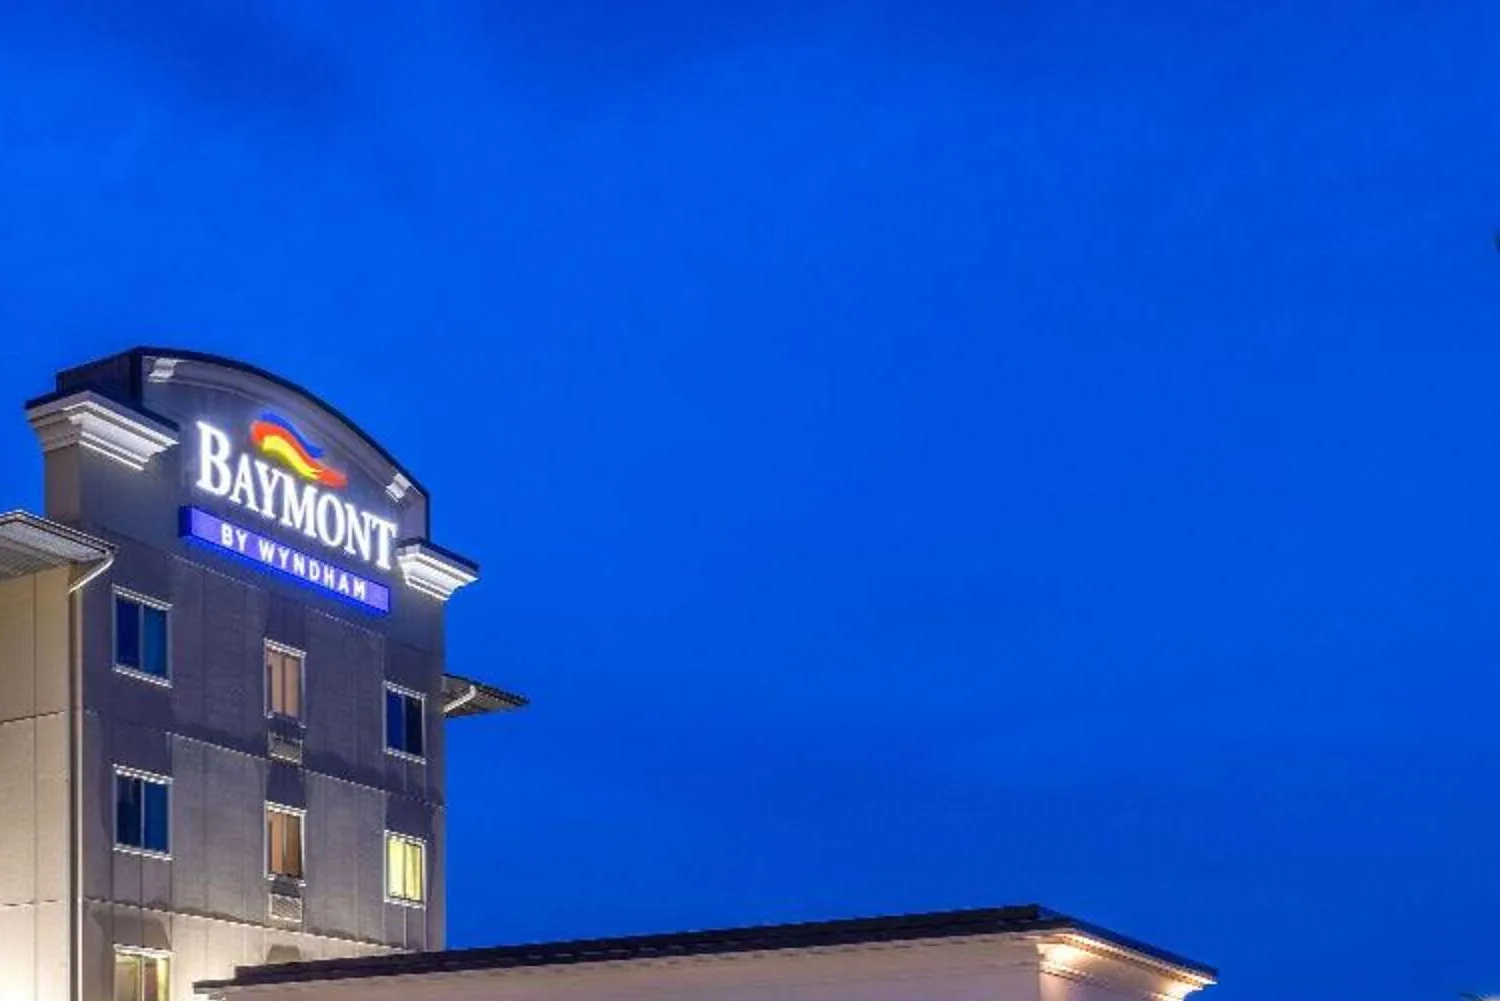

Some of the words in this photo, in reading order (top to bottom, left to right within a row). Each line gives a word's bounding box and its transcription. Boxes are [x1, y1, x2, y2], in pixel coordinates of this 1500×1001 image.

[197, 420, 397, 570] BAYMONT
[220, 523, 249, 554] BY
[258, 539, 367, 601] WYNDHAM
